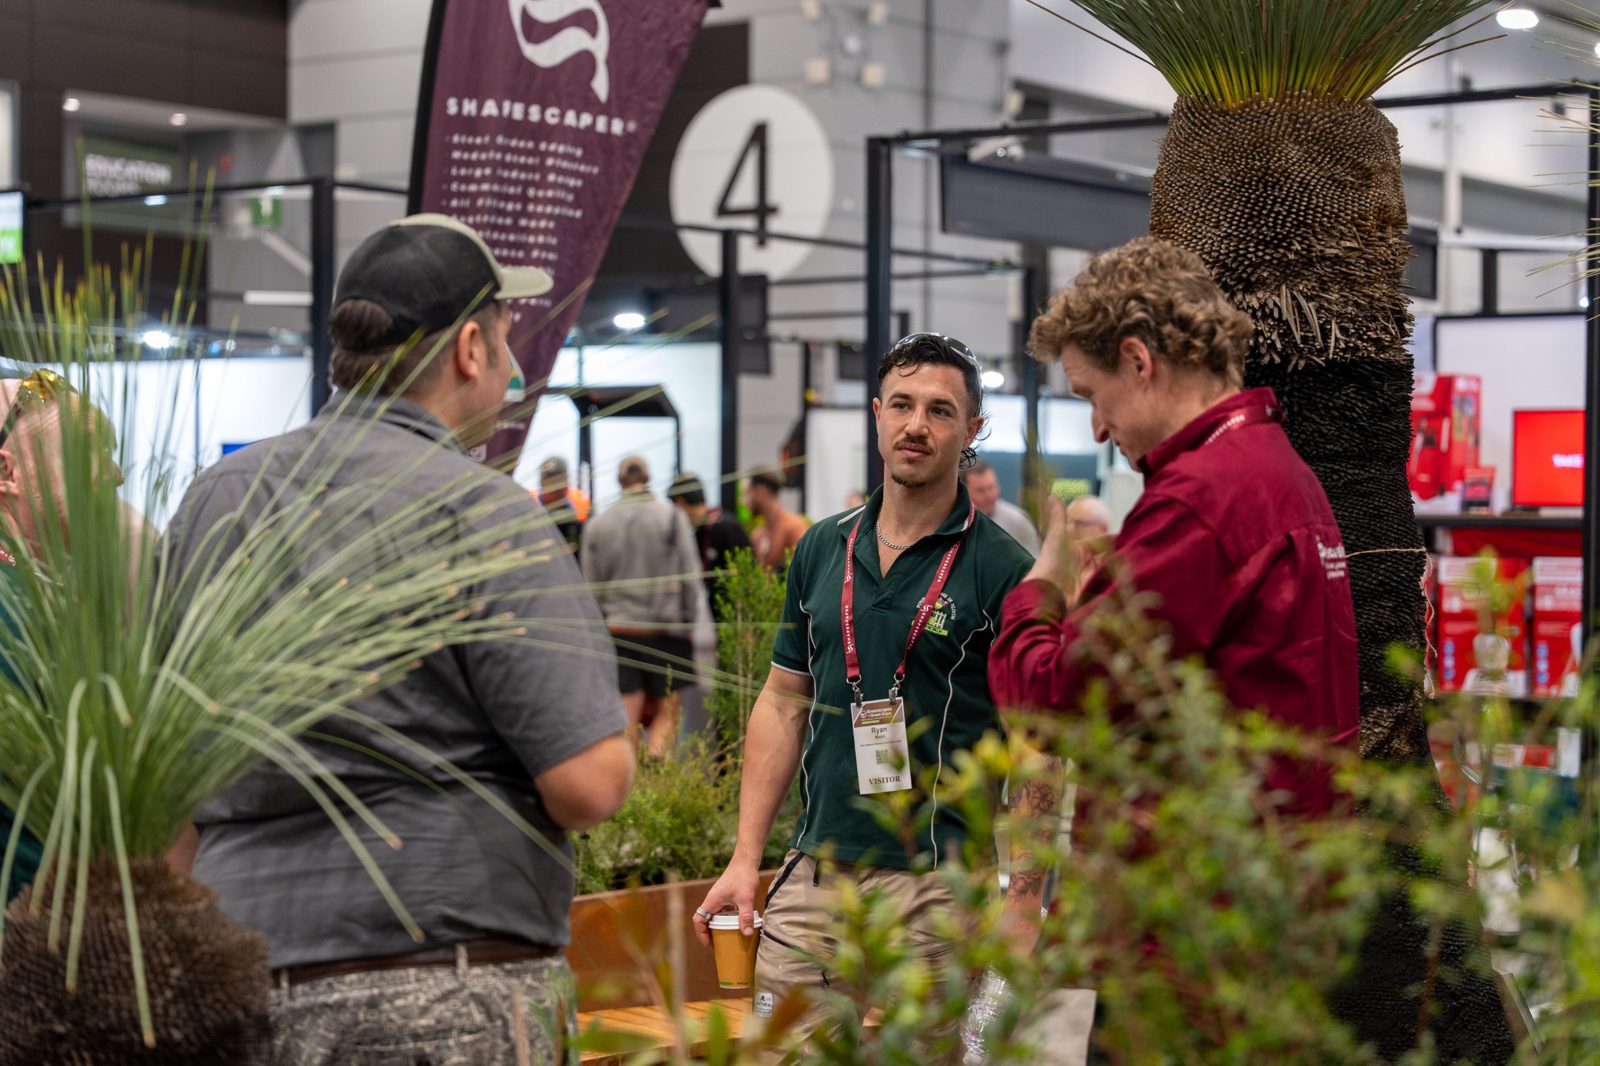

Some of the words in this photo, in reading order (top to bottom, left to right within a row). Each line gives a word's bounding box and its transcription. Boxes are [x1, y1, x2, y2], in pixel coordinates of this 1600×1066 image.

[716, 122, 779, 247] 4
[871, 727, 888, 735] Ryan
[869, 776, 901, 785] VISITOR
